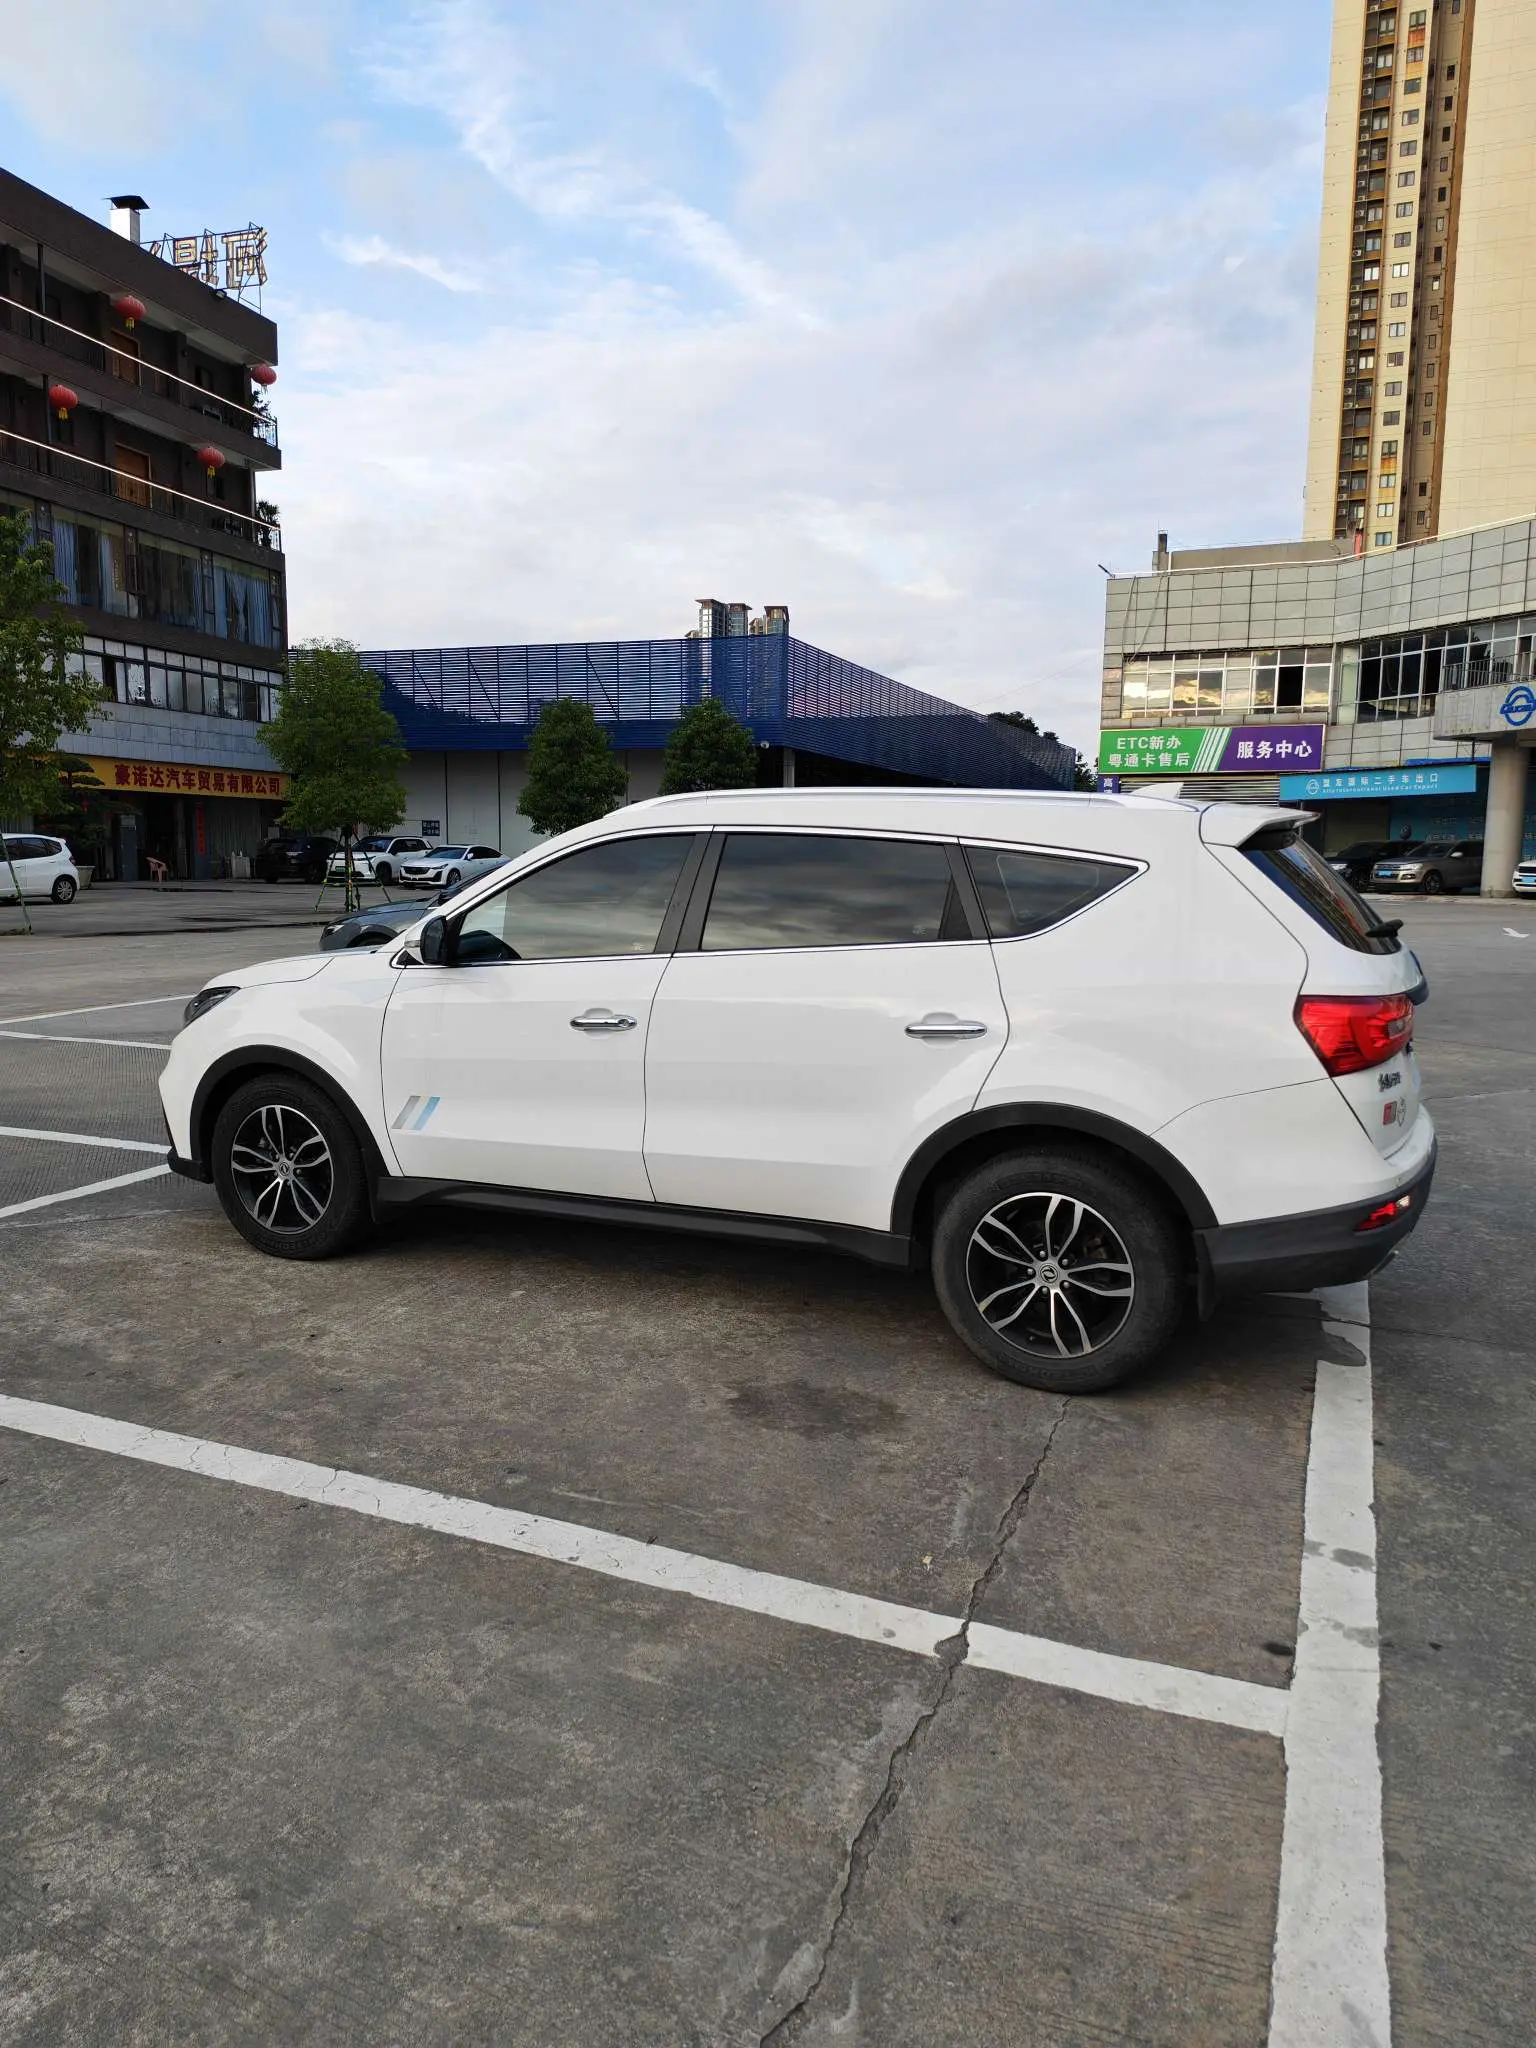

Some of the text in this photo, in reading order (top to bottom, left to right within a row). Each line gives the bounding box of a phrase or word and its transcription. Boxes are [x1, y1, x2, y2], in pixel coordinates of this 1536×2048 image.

[1116, 735, 1182, 750] ETC新办
[1236, 740, 1313, 759] 服务中心
[1107, 752, 1190, 768] 粤通卡售后
[114, 763, 281, 796] 豪诺达汽车贸易有限公司
